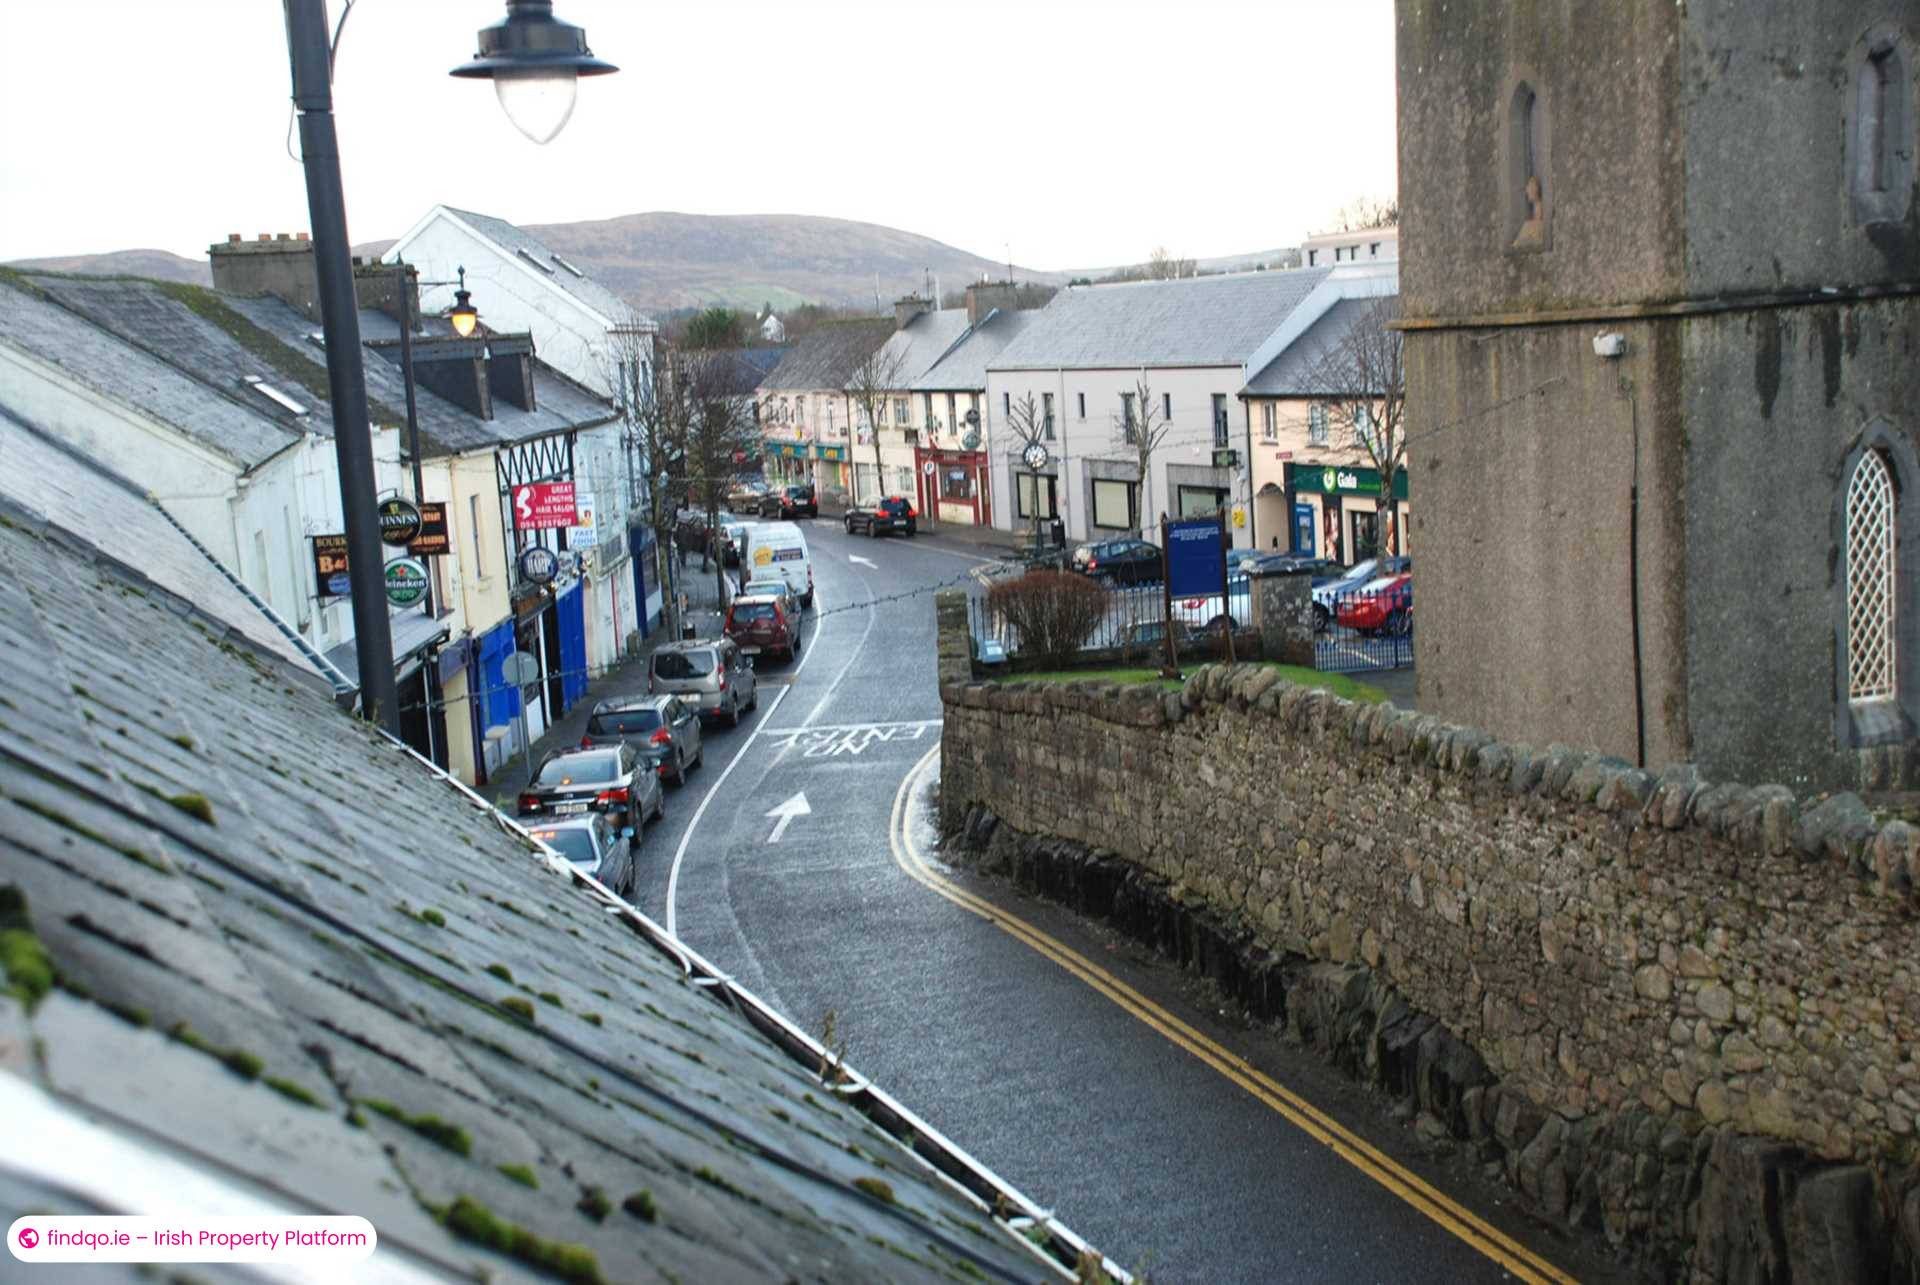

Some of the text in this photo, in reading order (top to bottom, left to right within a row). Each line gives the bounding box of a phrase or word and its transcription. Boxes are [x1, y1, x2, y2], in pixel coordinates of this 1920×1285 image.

[551, 485, 572, 494] GREAT
[536, 504, 575, 515] HAIR SALON
[574, 529, 594, 537] FAST
[319, 554, 349, 574] B&
